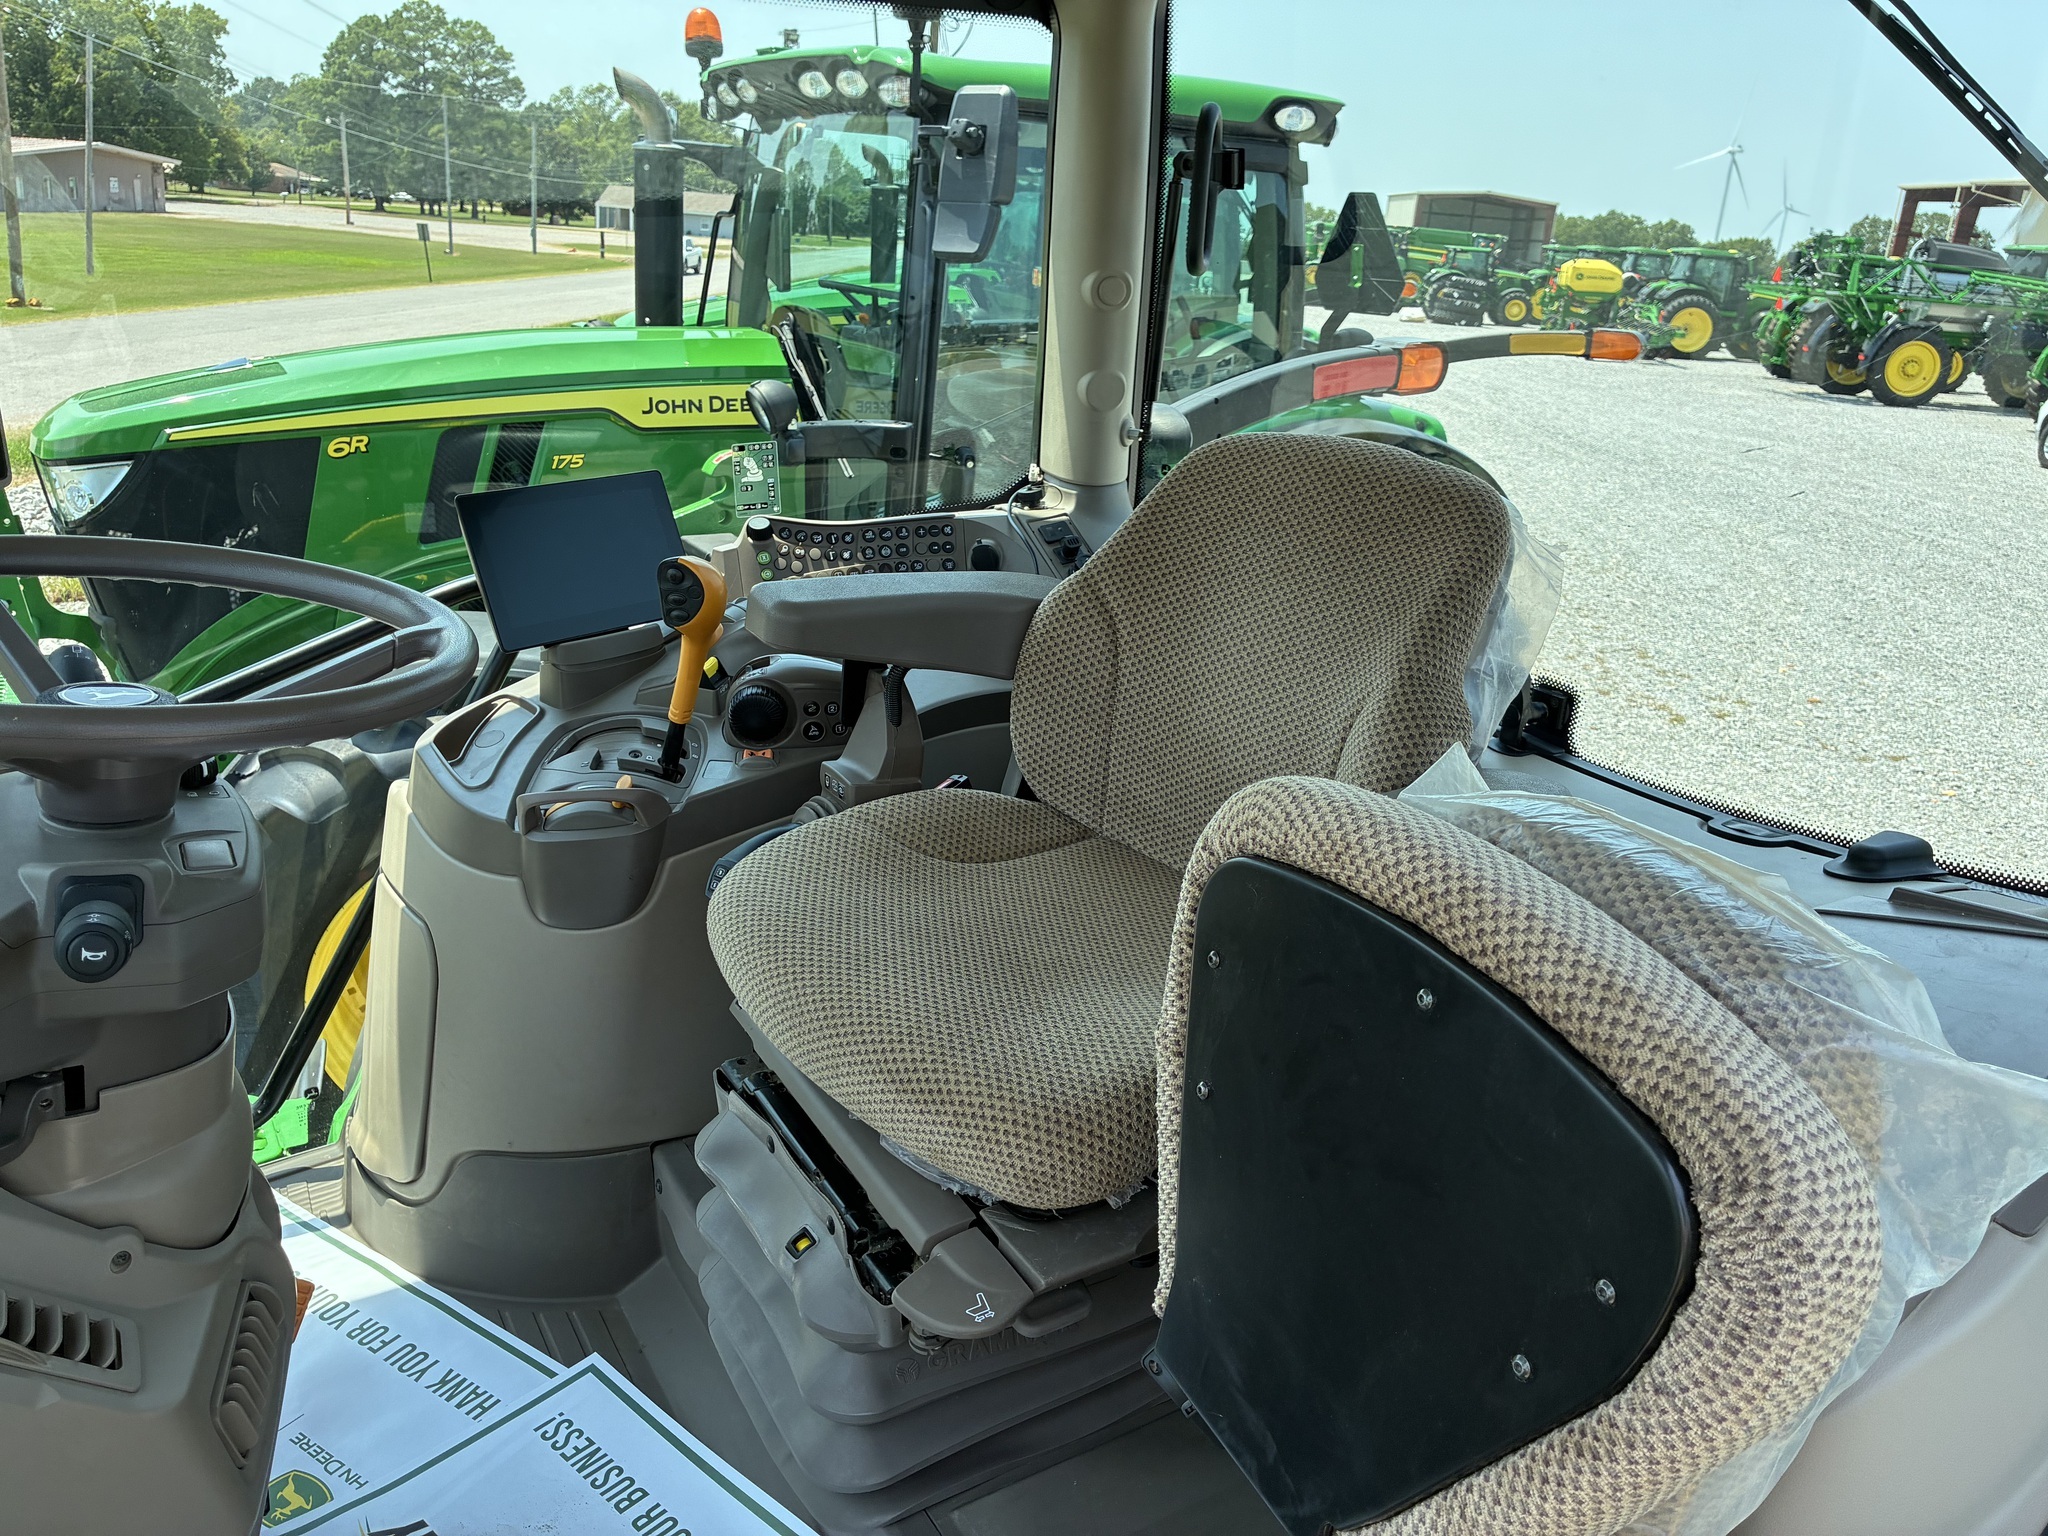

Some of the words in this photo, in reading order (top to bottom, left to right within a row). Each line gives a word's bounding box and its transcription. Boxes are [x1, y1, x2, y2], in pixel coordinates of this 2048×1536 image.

[641, 395, 703, 415] JOHN
[709, 395, 751, 413] DEE
[327, 435, 370, 459] 6R
[551, 453, 585, 470] 175
[345, 1317, 402, 1354] FOR
[383, 1343, 440, 1383] YOU
[424, 1368, 502, 1423] HANK
[289, 1431, 345, 1476] DEERE
[532, 1411, 651, 1515] BUSINESS!
[339, 1468, 369, 1490] HN
[631, 1502, 692, 1536] UR
